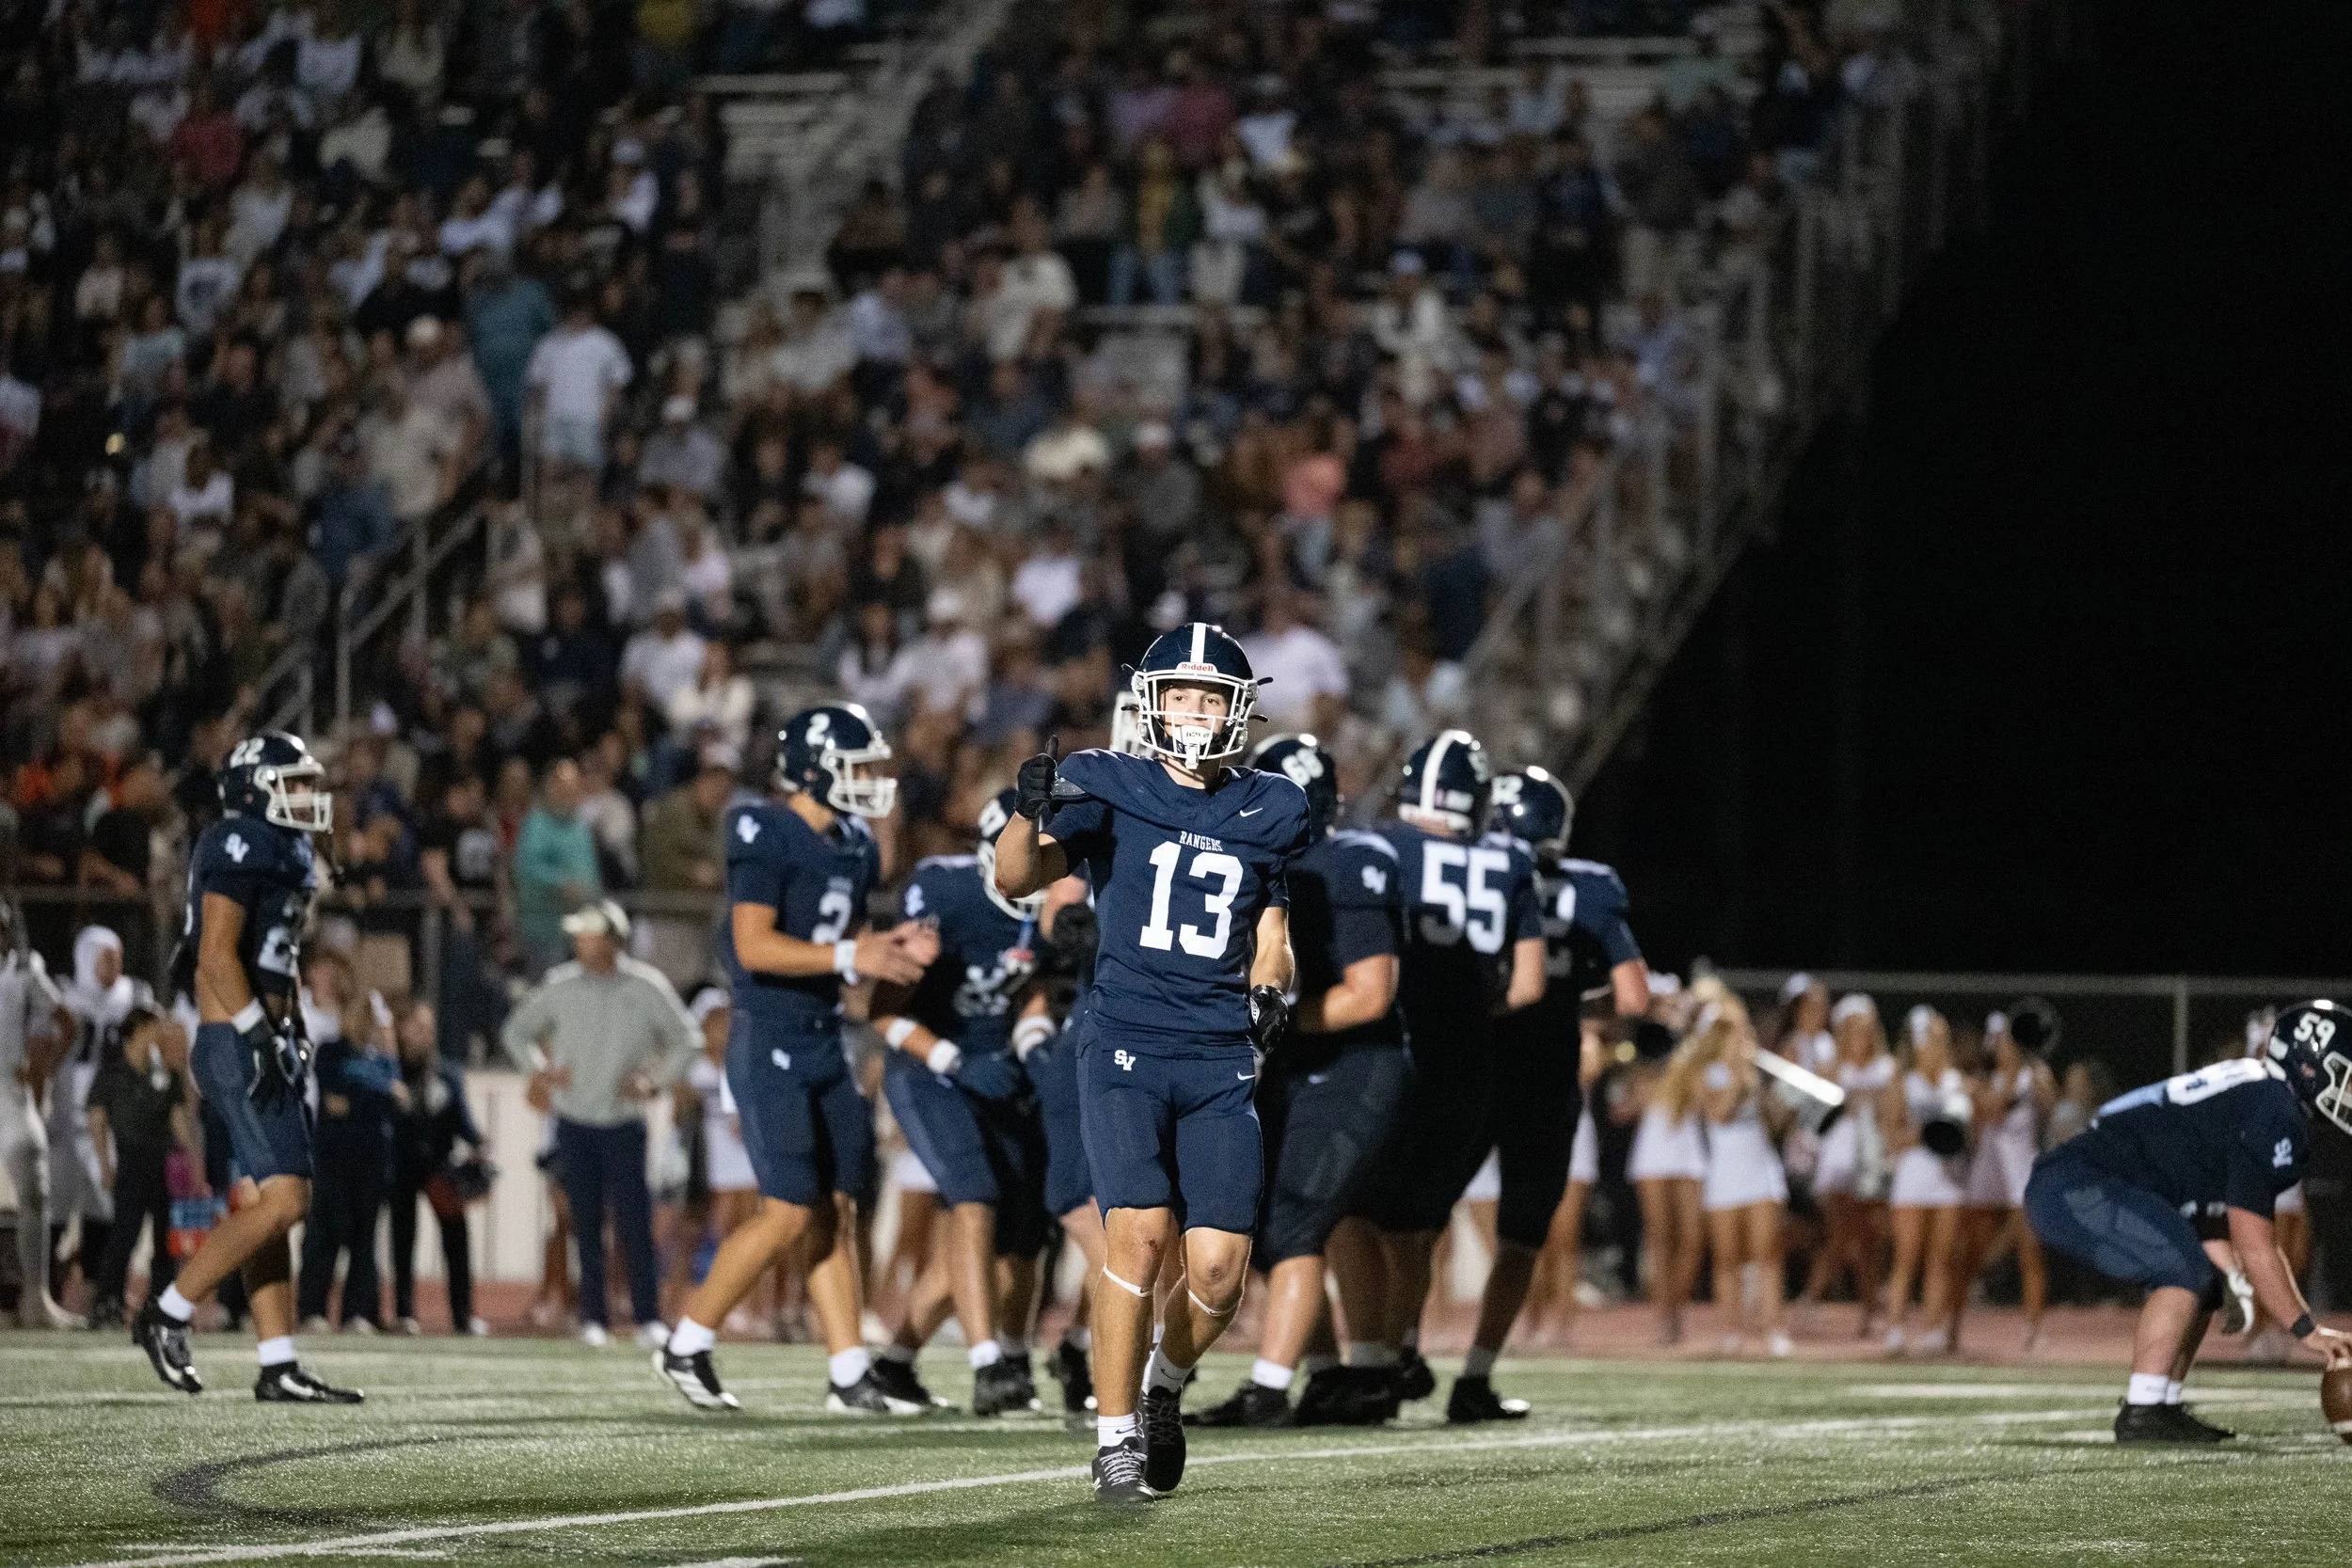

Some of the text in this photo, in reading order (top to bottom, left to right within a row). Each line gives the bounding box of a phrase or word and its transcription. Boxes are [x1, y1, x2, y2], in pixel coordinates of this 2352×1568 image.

[1181, 663, 1214, 672] Riddell
[805, 713, 831, 746] 2
[1179, 831, 1223, 852] RANGERS
[1139, 840, 1244, 959] 13
[1421, 840, 1510, 955] 55
[2294, 1012, 2336, 1051] 59
[1114, 1049, 1136, 1070] SV
